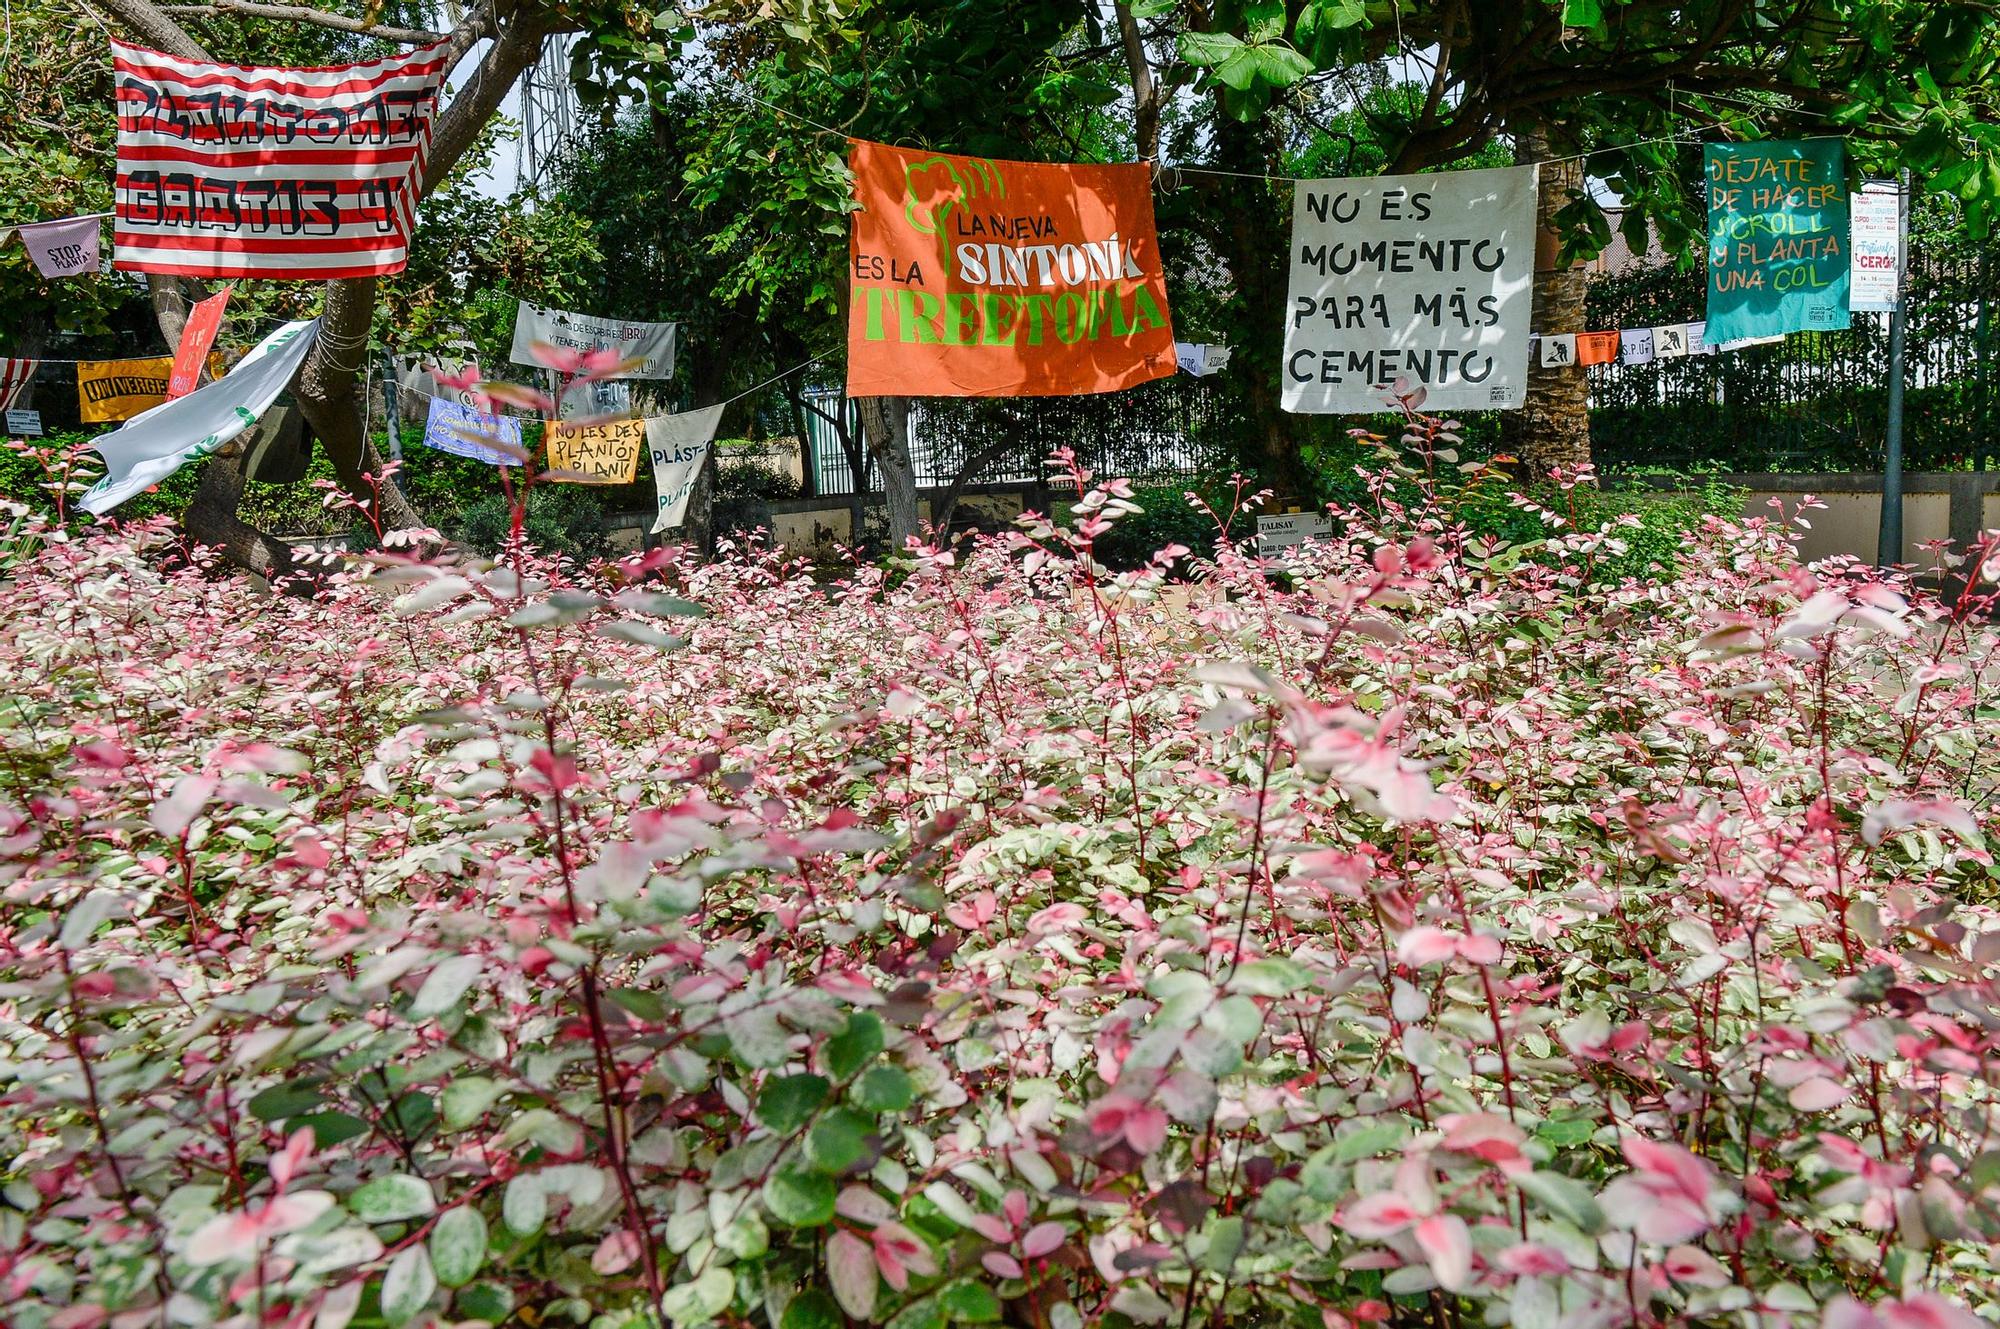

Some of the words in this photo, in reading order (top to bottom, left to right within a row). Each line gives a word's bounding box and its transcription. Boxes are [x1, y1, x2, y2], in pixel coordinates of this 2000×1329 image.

[1711, 154, 1815, 183] DÉJATE
[125, 170, 341, 235] GRATIS
[1306, 191, 1360, 224] NO
[1712, 187, 1743, 213] DE
[1752, 184, 1845, 210] HACER
[956, 211, 985, 237] LA
[1712, 212, 1831, 240] SCROLL
[47, 244, 81, 262] STOP
[956, 231, 1145, 288] SINTONÍA
[1301, 238, 1505, 276] MOMENTO
[1737, 235, 1840, 265] PLANTA
[855, 254, 884, 281] ES
[890, 257, 925, 286] LA
[1715, 269, 1766, 293] UNA
[1772, 264, 1829, 292] COL
[1294, 294, 1391, 329] PARA
[1288, 348, 1493, 385] CEMENTO
[555, 422, 576, 439] NO
[581, 424, 607, 439] LES
[615, 422, 641, 438] DES
[1260, 520, 1294, 531] TALISAY
